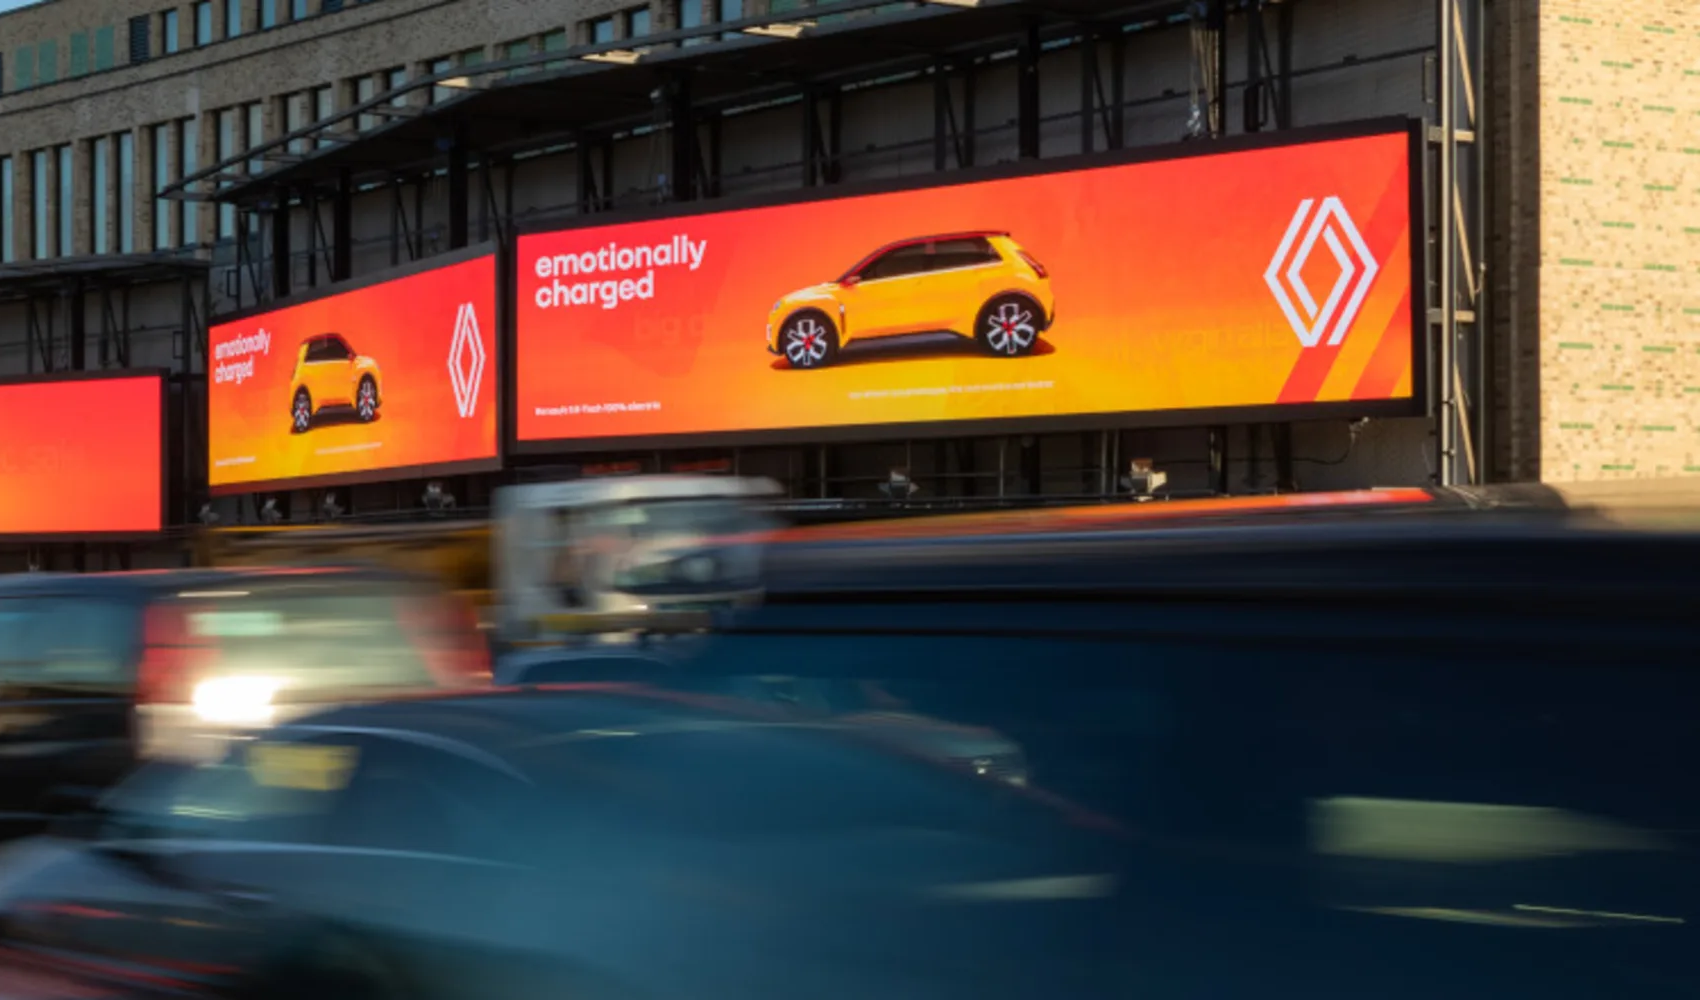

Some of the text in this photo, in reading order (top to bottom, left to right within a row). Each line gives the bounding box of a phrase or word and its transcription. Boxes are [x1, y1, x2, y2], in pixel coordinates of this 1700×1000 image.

[534, 234, 708, 278] emotionally
[535, 270, 654, 309] charged
[214, 327, 271, 361] emotionally
[214, 355, 254, 385] charged
